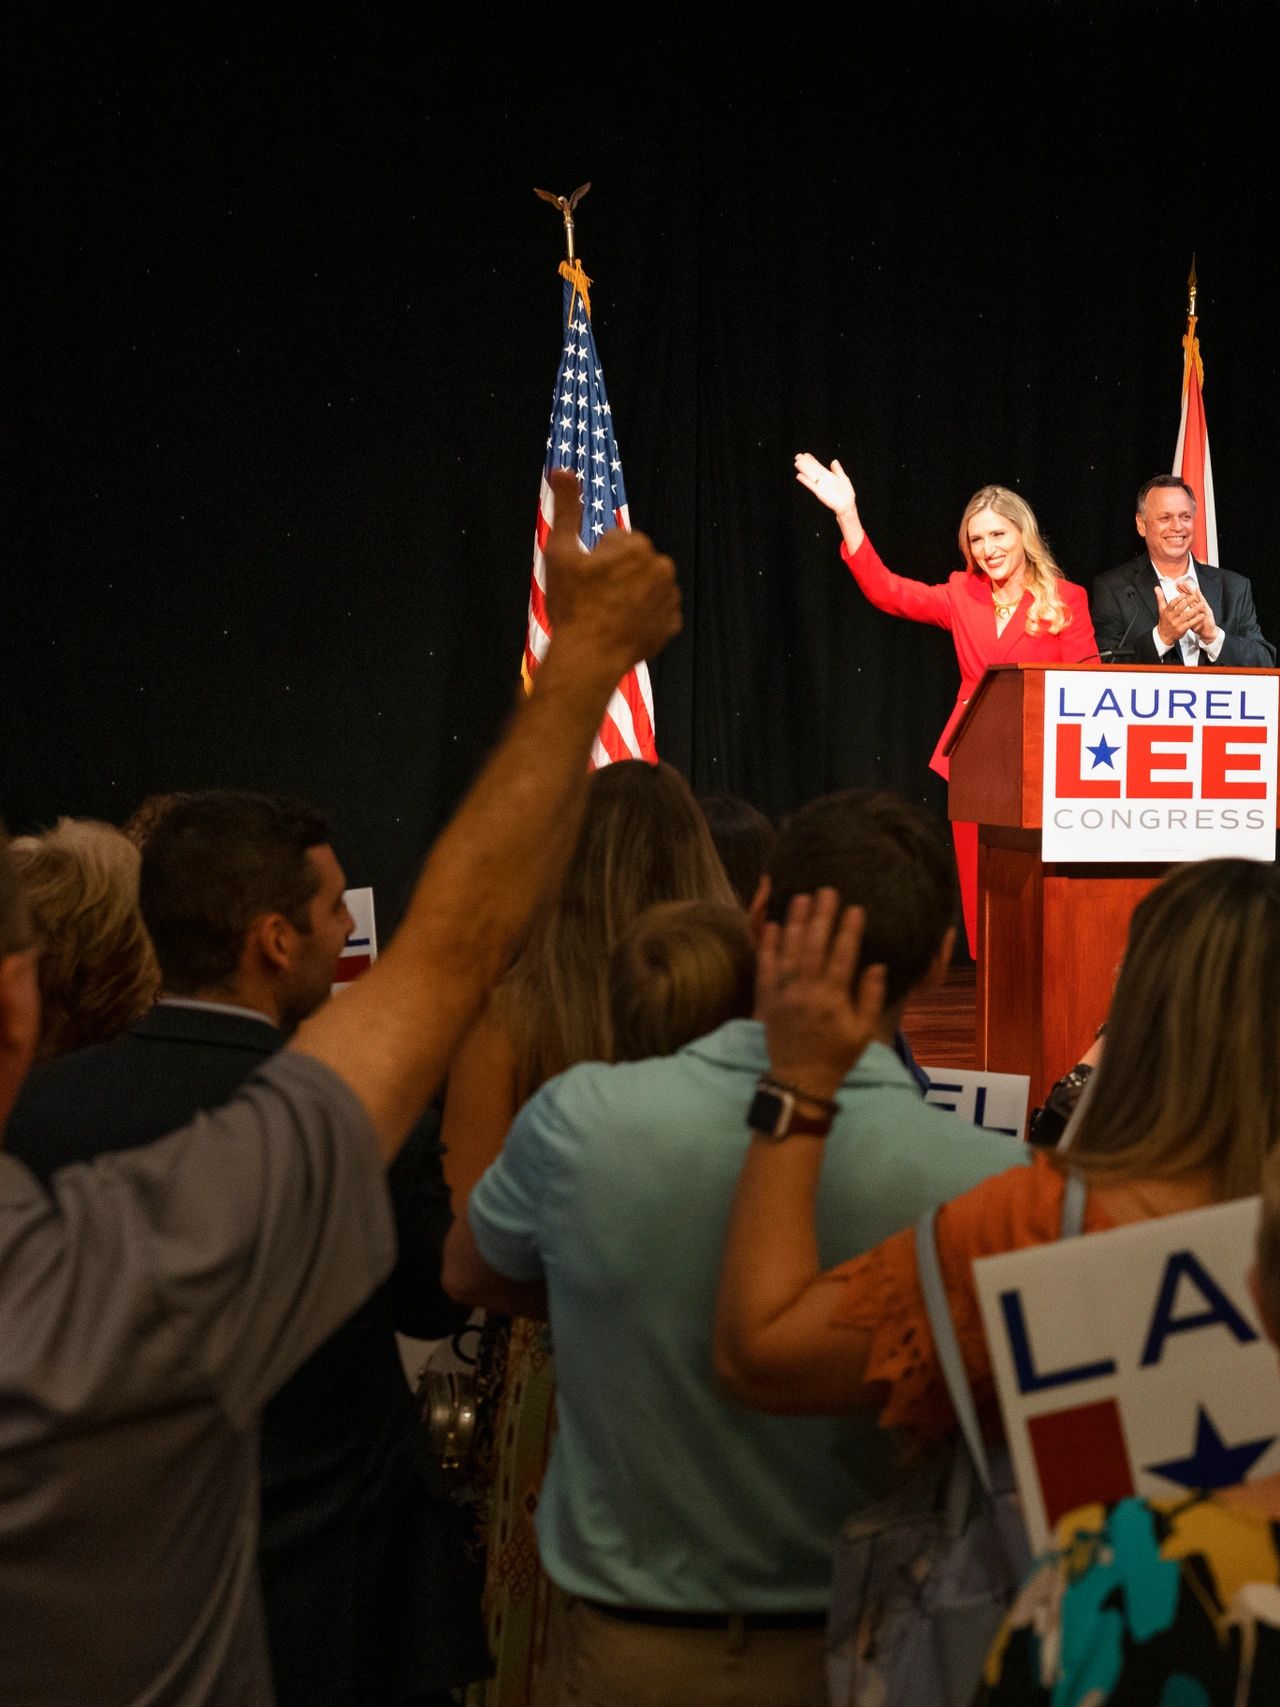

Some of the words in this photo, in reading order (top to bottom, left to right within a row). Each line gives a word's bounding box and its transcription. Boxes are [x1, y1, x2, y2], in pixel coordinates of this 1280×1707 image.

[1059, 687, 1265, 720] LAUREL
[1055, 723, 1267, 799] LEE
[1053, 808, 1265, 830] CONGRESS
